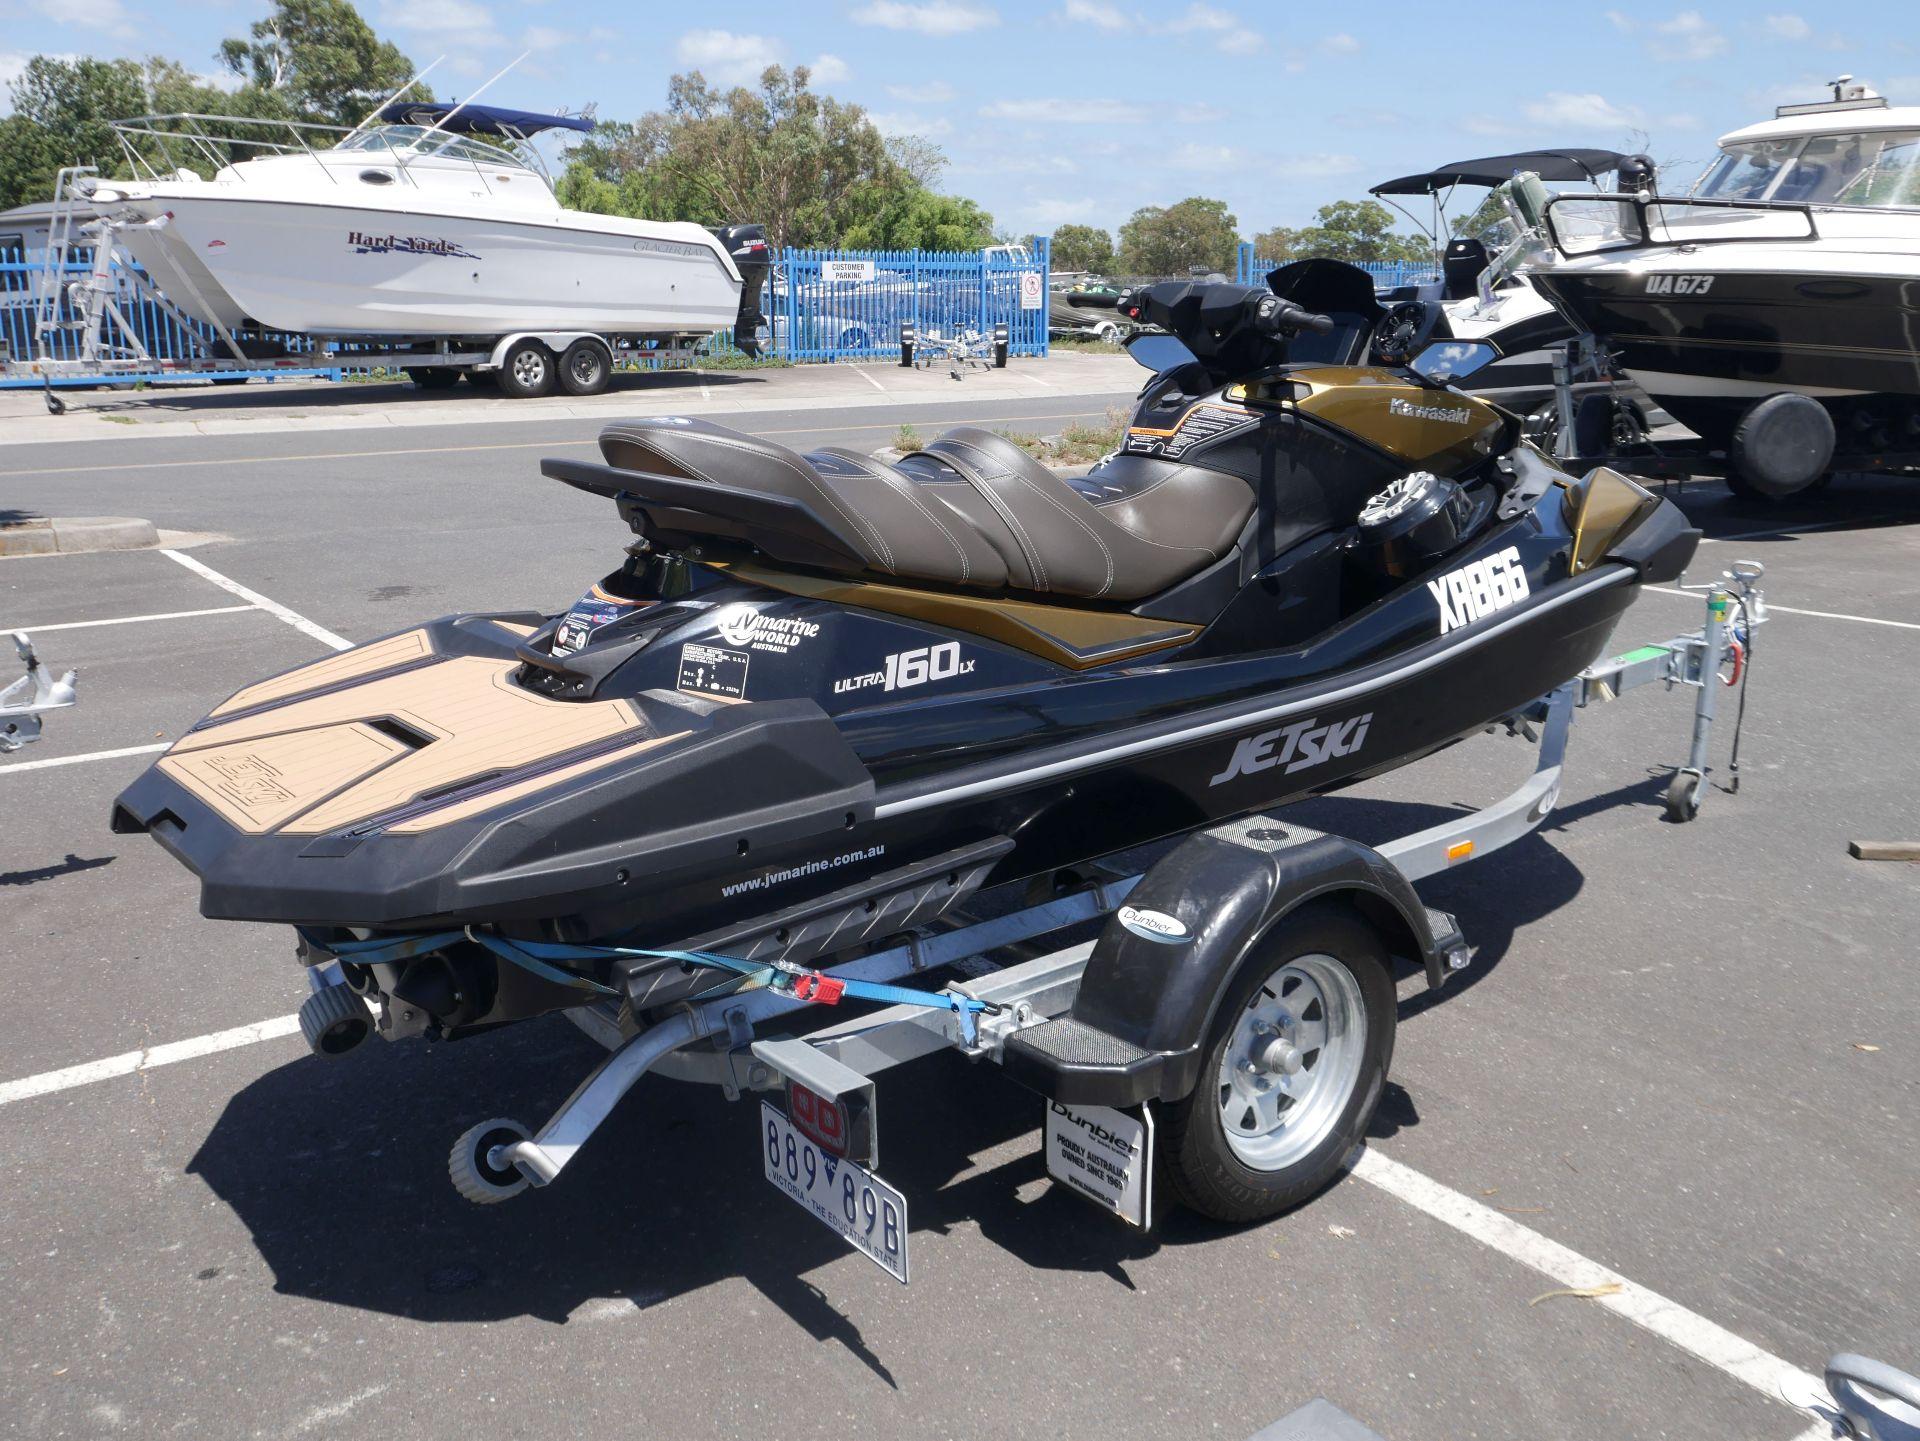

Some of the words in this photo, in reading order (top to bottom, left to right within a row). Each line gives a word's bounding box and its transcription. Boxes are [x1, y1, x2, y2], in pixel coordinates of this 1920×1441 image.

[348, 232, 394, 248] Hard
[407, 237, 456, 254] Yards
[832, 263, 865, 271] CUSTOMER
[835, 272, 862, 280] PARKING
[1389, 397, 1471, 425] Kawasaki
[751, 641, 788, 654] AUSTRALIA
[753, 629, 801, 647] WORLD
[834, 671, 887, 694] ULTRA
[884, 641, 961, 692] 160
[959, 659, 976, 675] LX
[721, 844, 886, 898] www.jvmarine.com.au
[1123, 909, 1174, 933] Dunbier
[1050, 1101, 1139, 1154] Dunbier
[1057, 1133, 1086, 1158] PROUDLY
[1086, 1151, 1129, 1183] AUSTRALIAN
[1061, 1148, 1086, 1170] OWNED
[1086, 1163, 1105, 1182] SINCE
[767, 1119, 817, 1192] 889
[843, 1172, 900, 1255] 89B
[772, 1170, 805, 1202] VICTORIA
[812, 1201, 826, 1218] THE
[827, 1211, 872, 1254] EDUCATION
[873, 1245, 899, 1273] STATE
